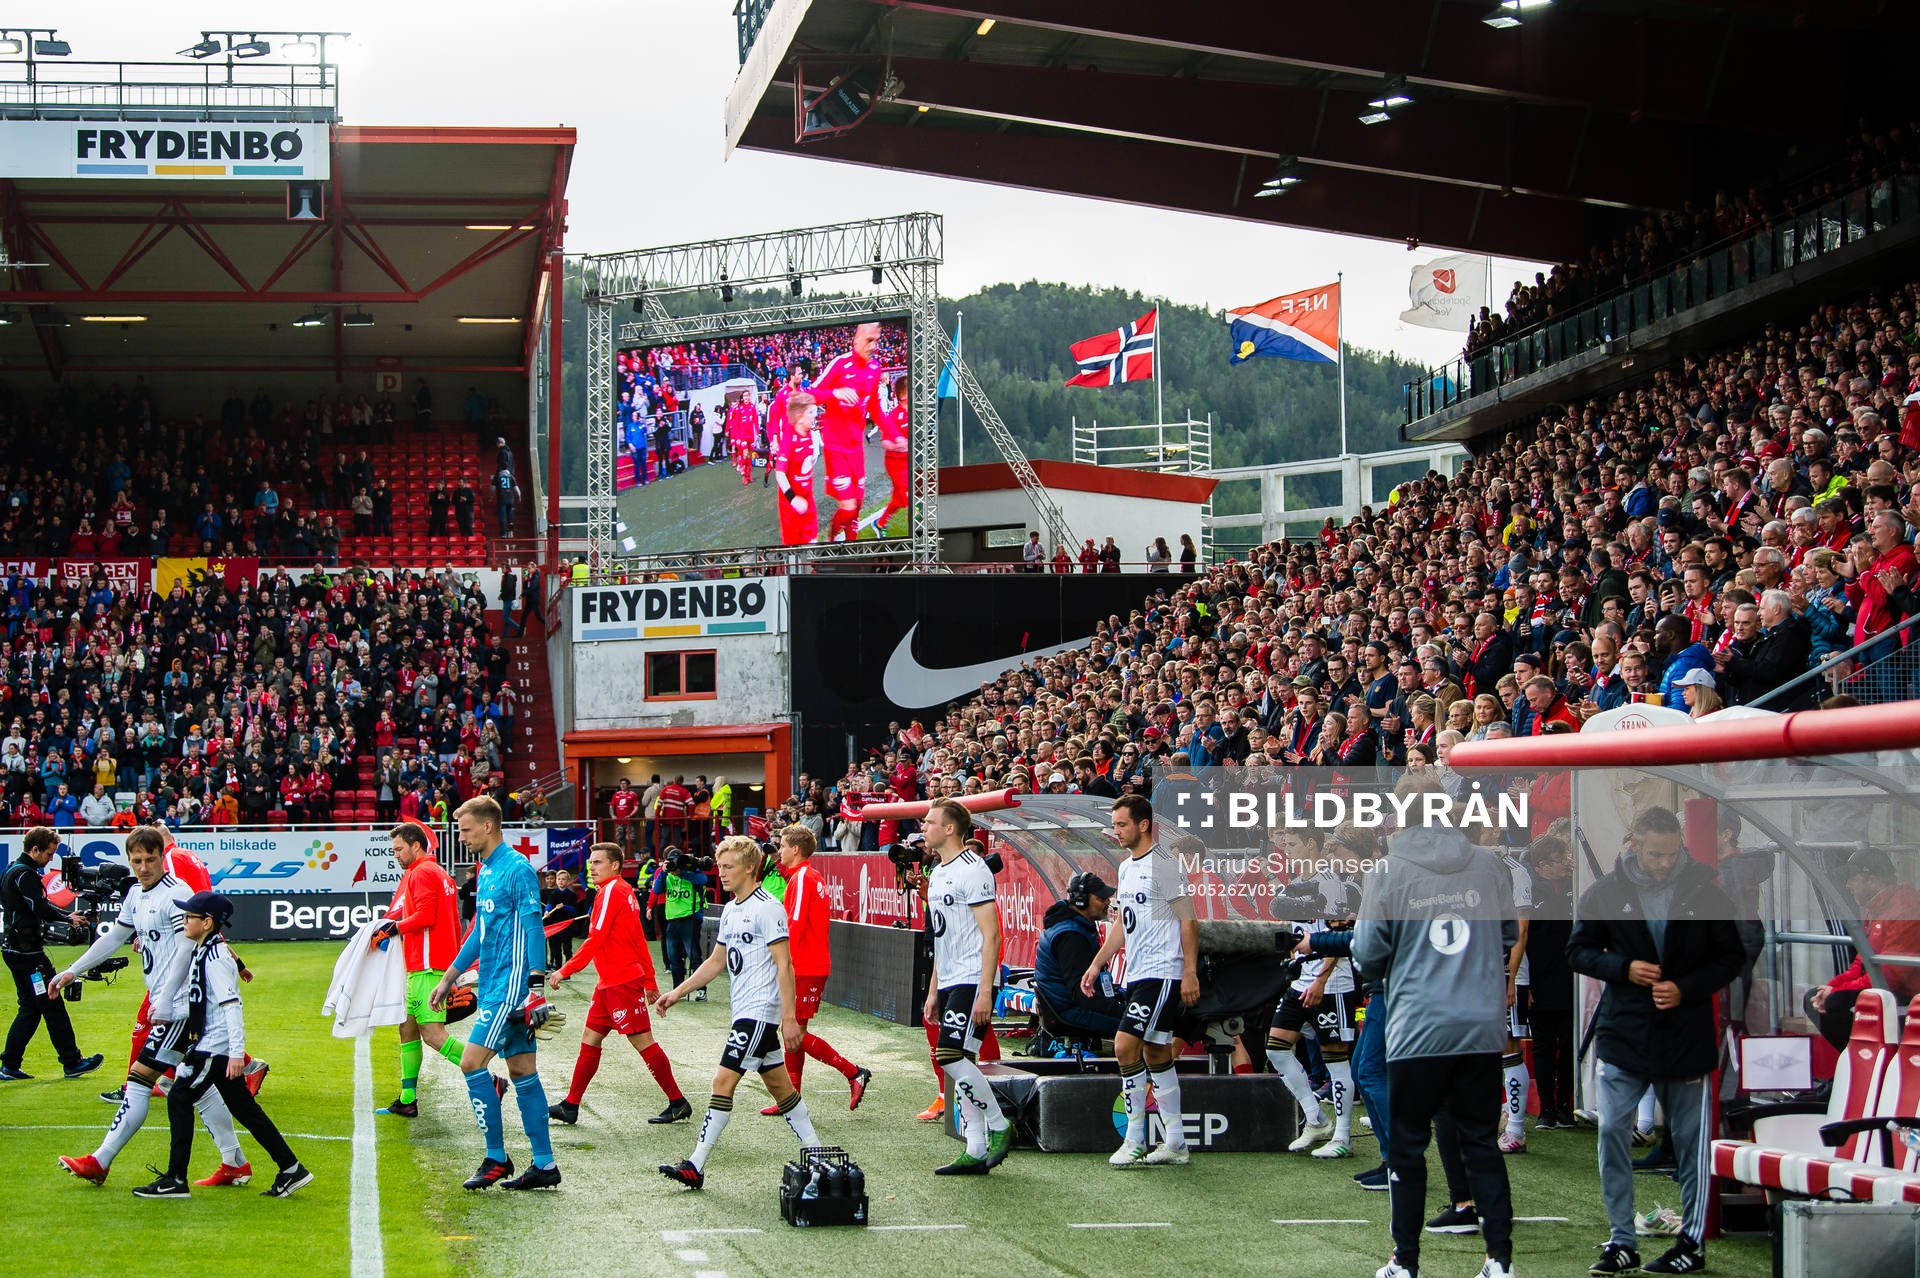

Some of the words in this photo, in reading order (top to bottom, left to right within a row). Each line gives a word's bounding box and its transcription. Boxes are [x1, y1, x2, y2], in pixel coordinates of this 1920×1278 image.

[77, 128, 303, 162] FRYDENBØ
[383, 373, 398, 388] D
[501, 477, 510, 488] 21
[581, 579, 766, 623] FRYDENBØ
[515, 646, 528, 654] 13
[517, 662, 530, 670] 12
[521, 694, 533, 703] 10
[527, 743, 534, 753] 7
[220, 839, 277, 851] bilskade
[387, 861, 395, 869] &
